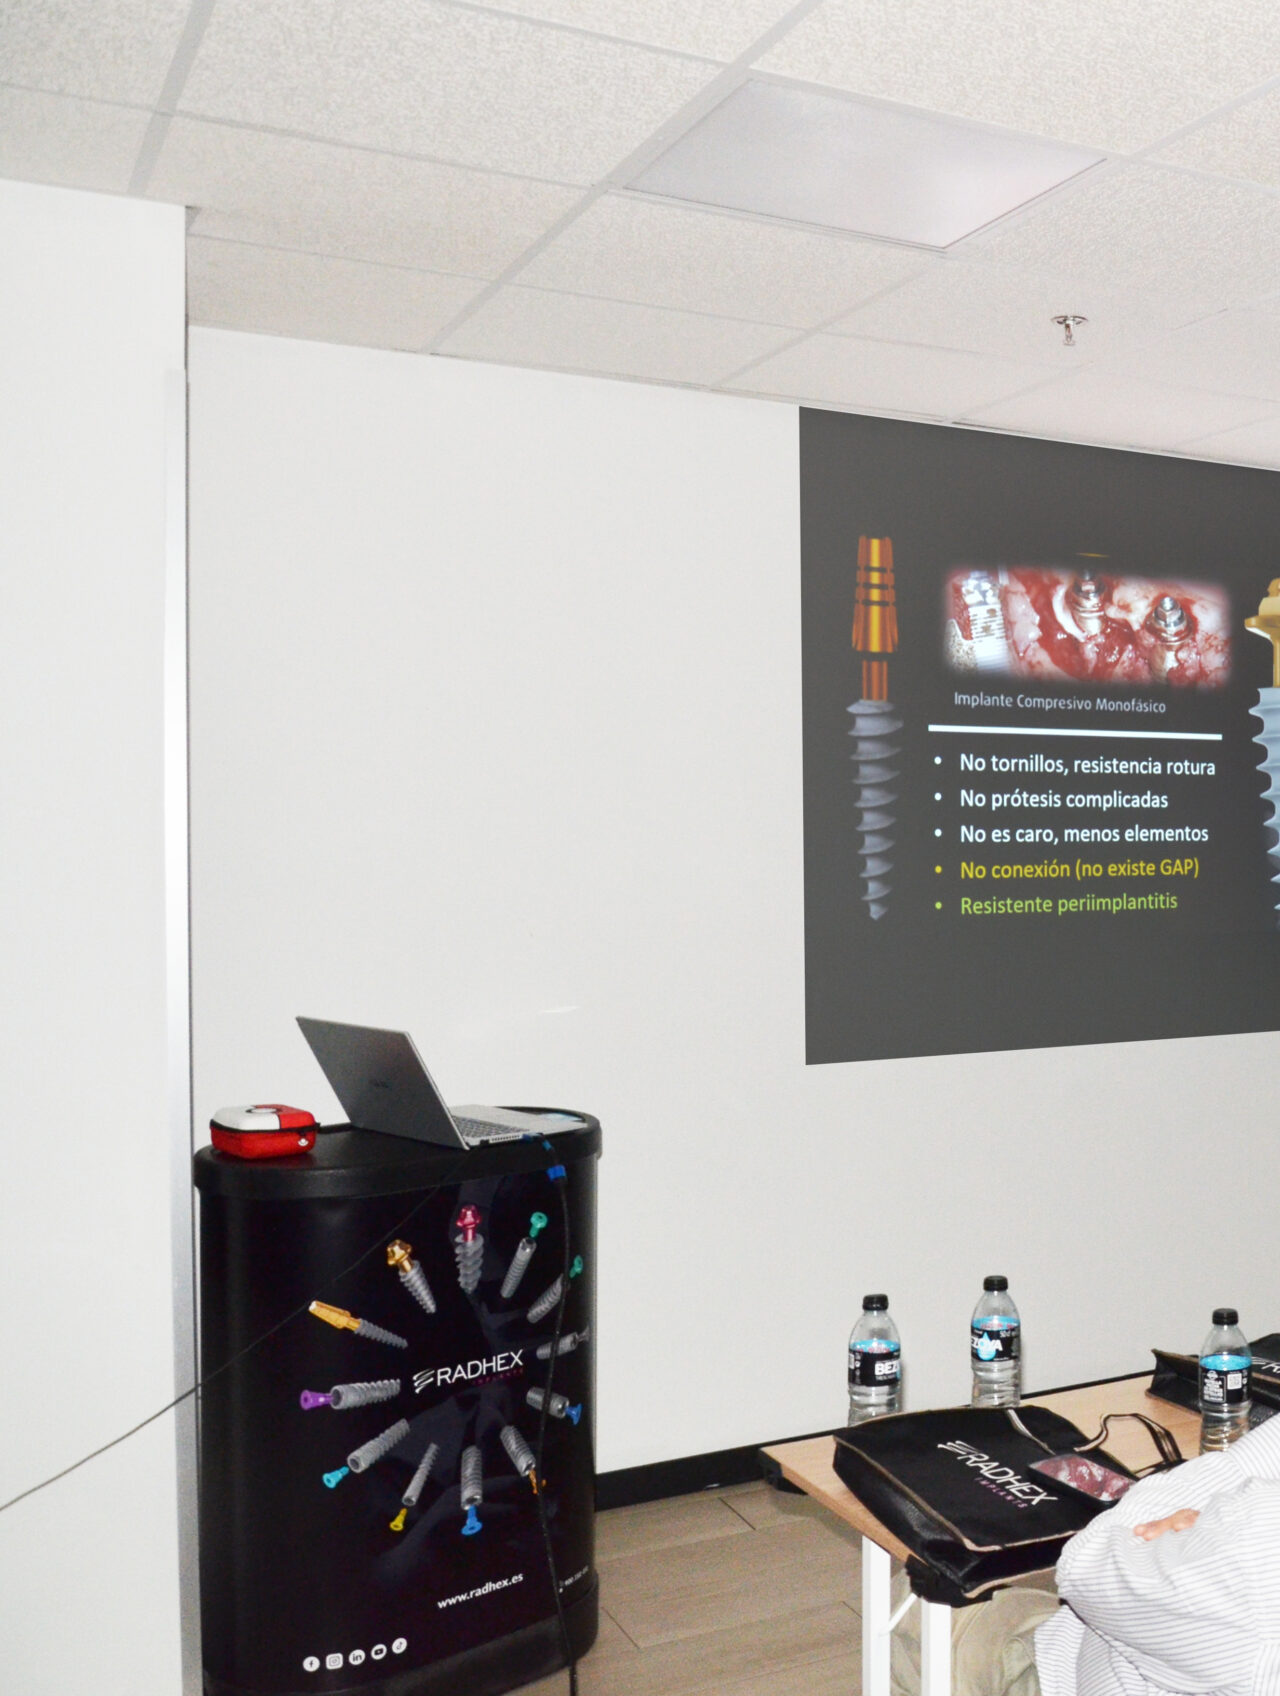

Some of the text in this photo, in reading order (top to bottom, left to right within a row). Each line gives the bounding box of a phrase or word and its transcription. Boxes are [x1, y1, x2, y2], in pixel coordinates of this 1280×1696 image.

[954, 691, 1166, 713] Implante Compresivo Monofásico
[960, 753, 1216, 776] No tornillos, resistencia rotura
[960, 788, 1168, 811] No prótesis complicadas
[960, 824, 1209, 845] No es caro, menos elementos
[960, 857, 1199, 880] No conexión (no existe GAP)
[961, 892, 1178, 915] Resistente periimplantitis
[970, 1336, 1003, 1351] EZOYA
[437, 1349, 524, 1387] RADHEX
[874, 1360, 899, 1376] BEZ
[956, 1453, 1058, 1506] RADHEX
[437, 1573, 524, 1609] www.radhex.es
